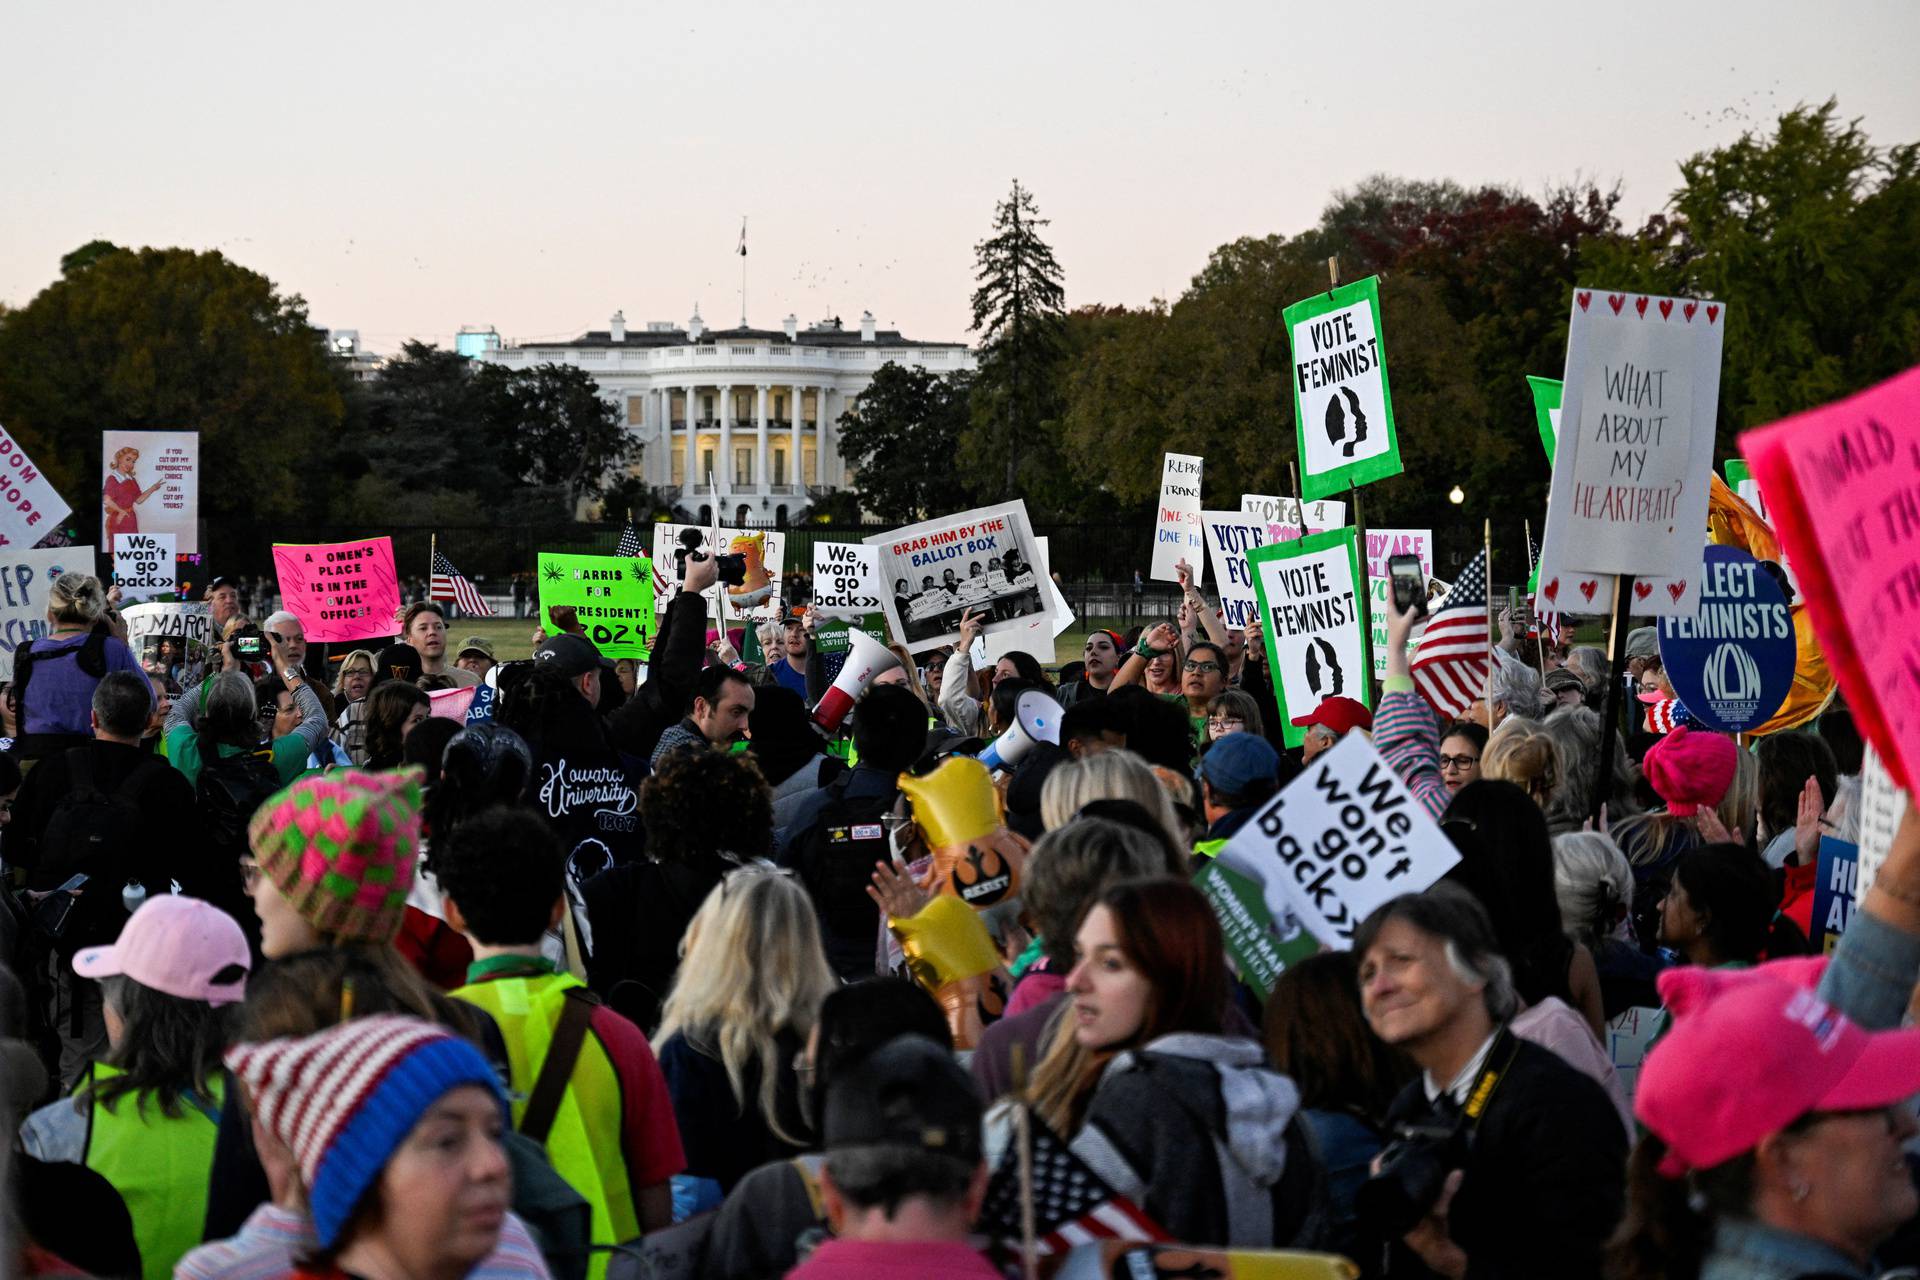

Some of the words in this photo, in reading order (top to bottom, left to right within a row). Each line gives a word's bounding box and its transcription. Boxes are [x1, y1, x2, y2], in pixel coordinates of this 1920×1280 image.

[1310, 312, 1356, 353] VOTE
[1296, 337, 1378, 393] FEMINIST
[1605, 362, 1669, 410] WHAT
[1596, 412, 1668, 446] ABOUT
[1611, 450, 1647, 482] MY
[0, 474, 42, 527] HOPE
[1314, 502, 1326, 521] 4
[1574, 479, 1683, 534] HEARTBEAT?
[127, 535, 156, 549] We
[892, 537, 929, 555] GRAB
[930, 530, 957, 546] HIM
[959, 525, 976, 539] BY
[979, 519, 1004, 534] THE
[911, 543, 963, 567] BALLOT
[967, 536, 997, 553] BOX
[1159, 528, 1181, 544] ONE
[1212, 524, 1263, 554] VOTE
[1391, 535, 1424, 561] ARE
[116, 548, 167, 561] won't
[135, 561, 158, 575] go
[305, 553, 313, 563] A
[816, 561, 869, 577] won't
[827, 545, 857, 562] We
[115, 573, 157, 587] back
[318, 564, 362, 576] PLACE
[573, 569, 623, 581] HARRIS
[834, 577, 859, 593] go
[1225, 557, 1253, 588] FO
[1279, 562, 1330, 600] VOTE
[1700, 562, 1757, 598] LECT
[311, 583, 323, 592] IS
[328, 582, 341, 592] IN
[344, 580, 367, 590] THE
[327, 594, 362, 607] OVAL
[586, 586, 612, 597] FOR
[814, 590, 861, 607] back
[320, 606, 371, 620] OFFICE!
[1271, 591, 1355, 638] FEMINIST
[1664, 603, 1789, 639] FEMINISTS
[148, 614, 213, 647] MARCH
[826, 638, 848, 646] WHIT
[1703, 642, 1762, 700] NOW
[548, 782, 637, 818] University
[1357, 762, 1412, 840] We
[1315, 764, 1412, 881] won't
[1257, 799, 1337, 911] back
[1313, 827, 1368, 881] go
[1256, 938, 1287, 976] MAR
